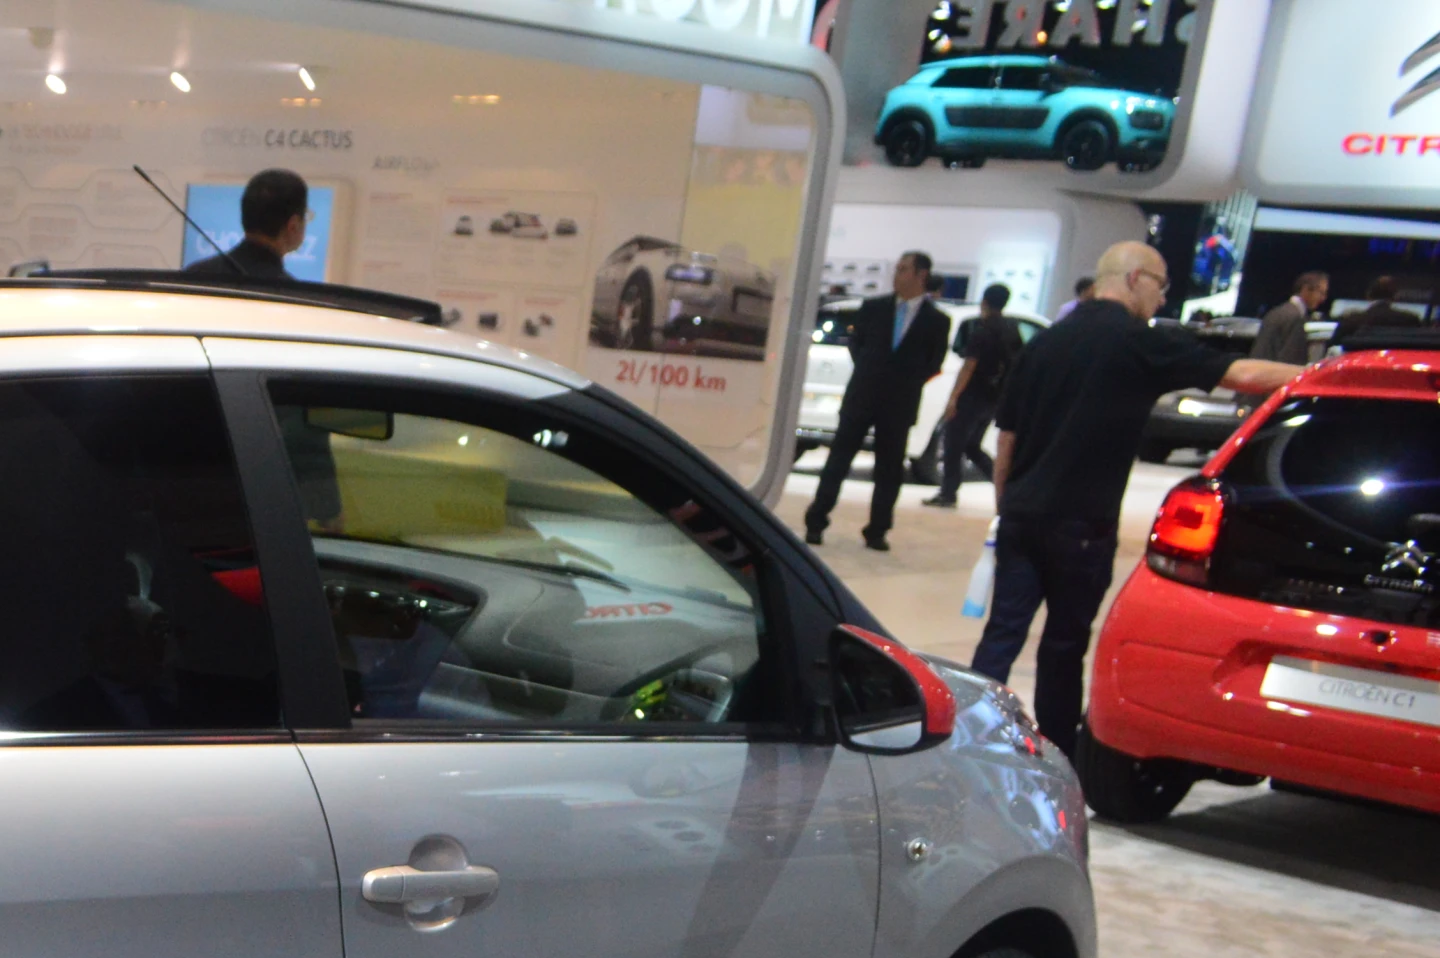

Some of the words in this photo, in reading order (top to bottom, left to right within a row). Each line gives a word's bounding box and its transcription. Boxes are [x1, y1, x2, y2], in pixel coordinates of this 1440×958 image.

[264, 128, 285, 148] C4
[288, 129, 354, 149] CACTUS
[694, 365, 727, 391] km
